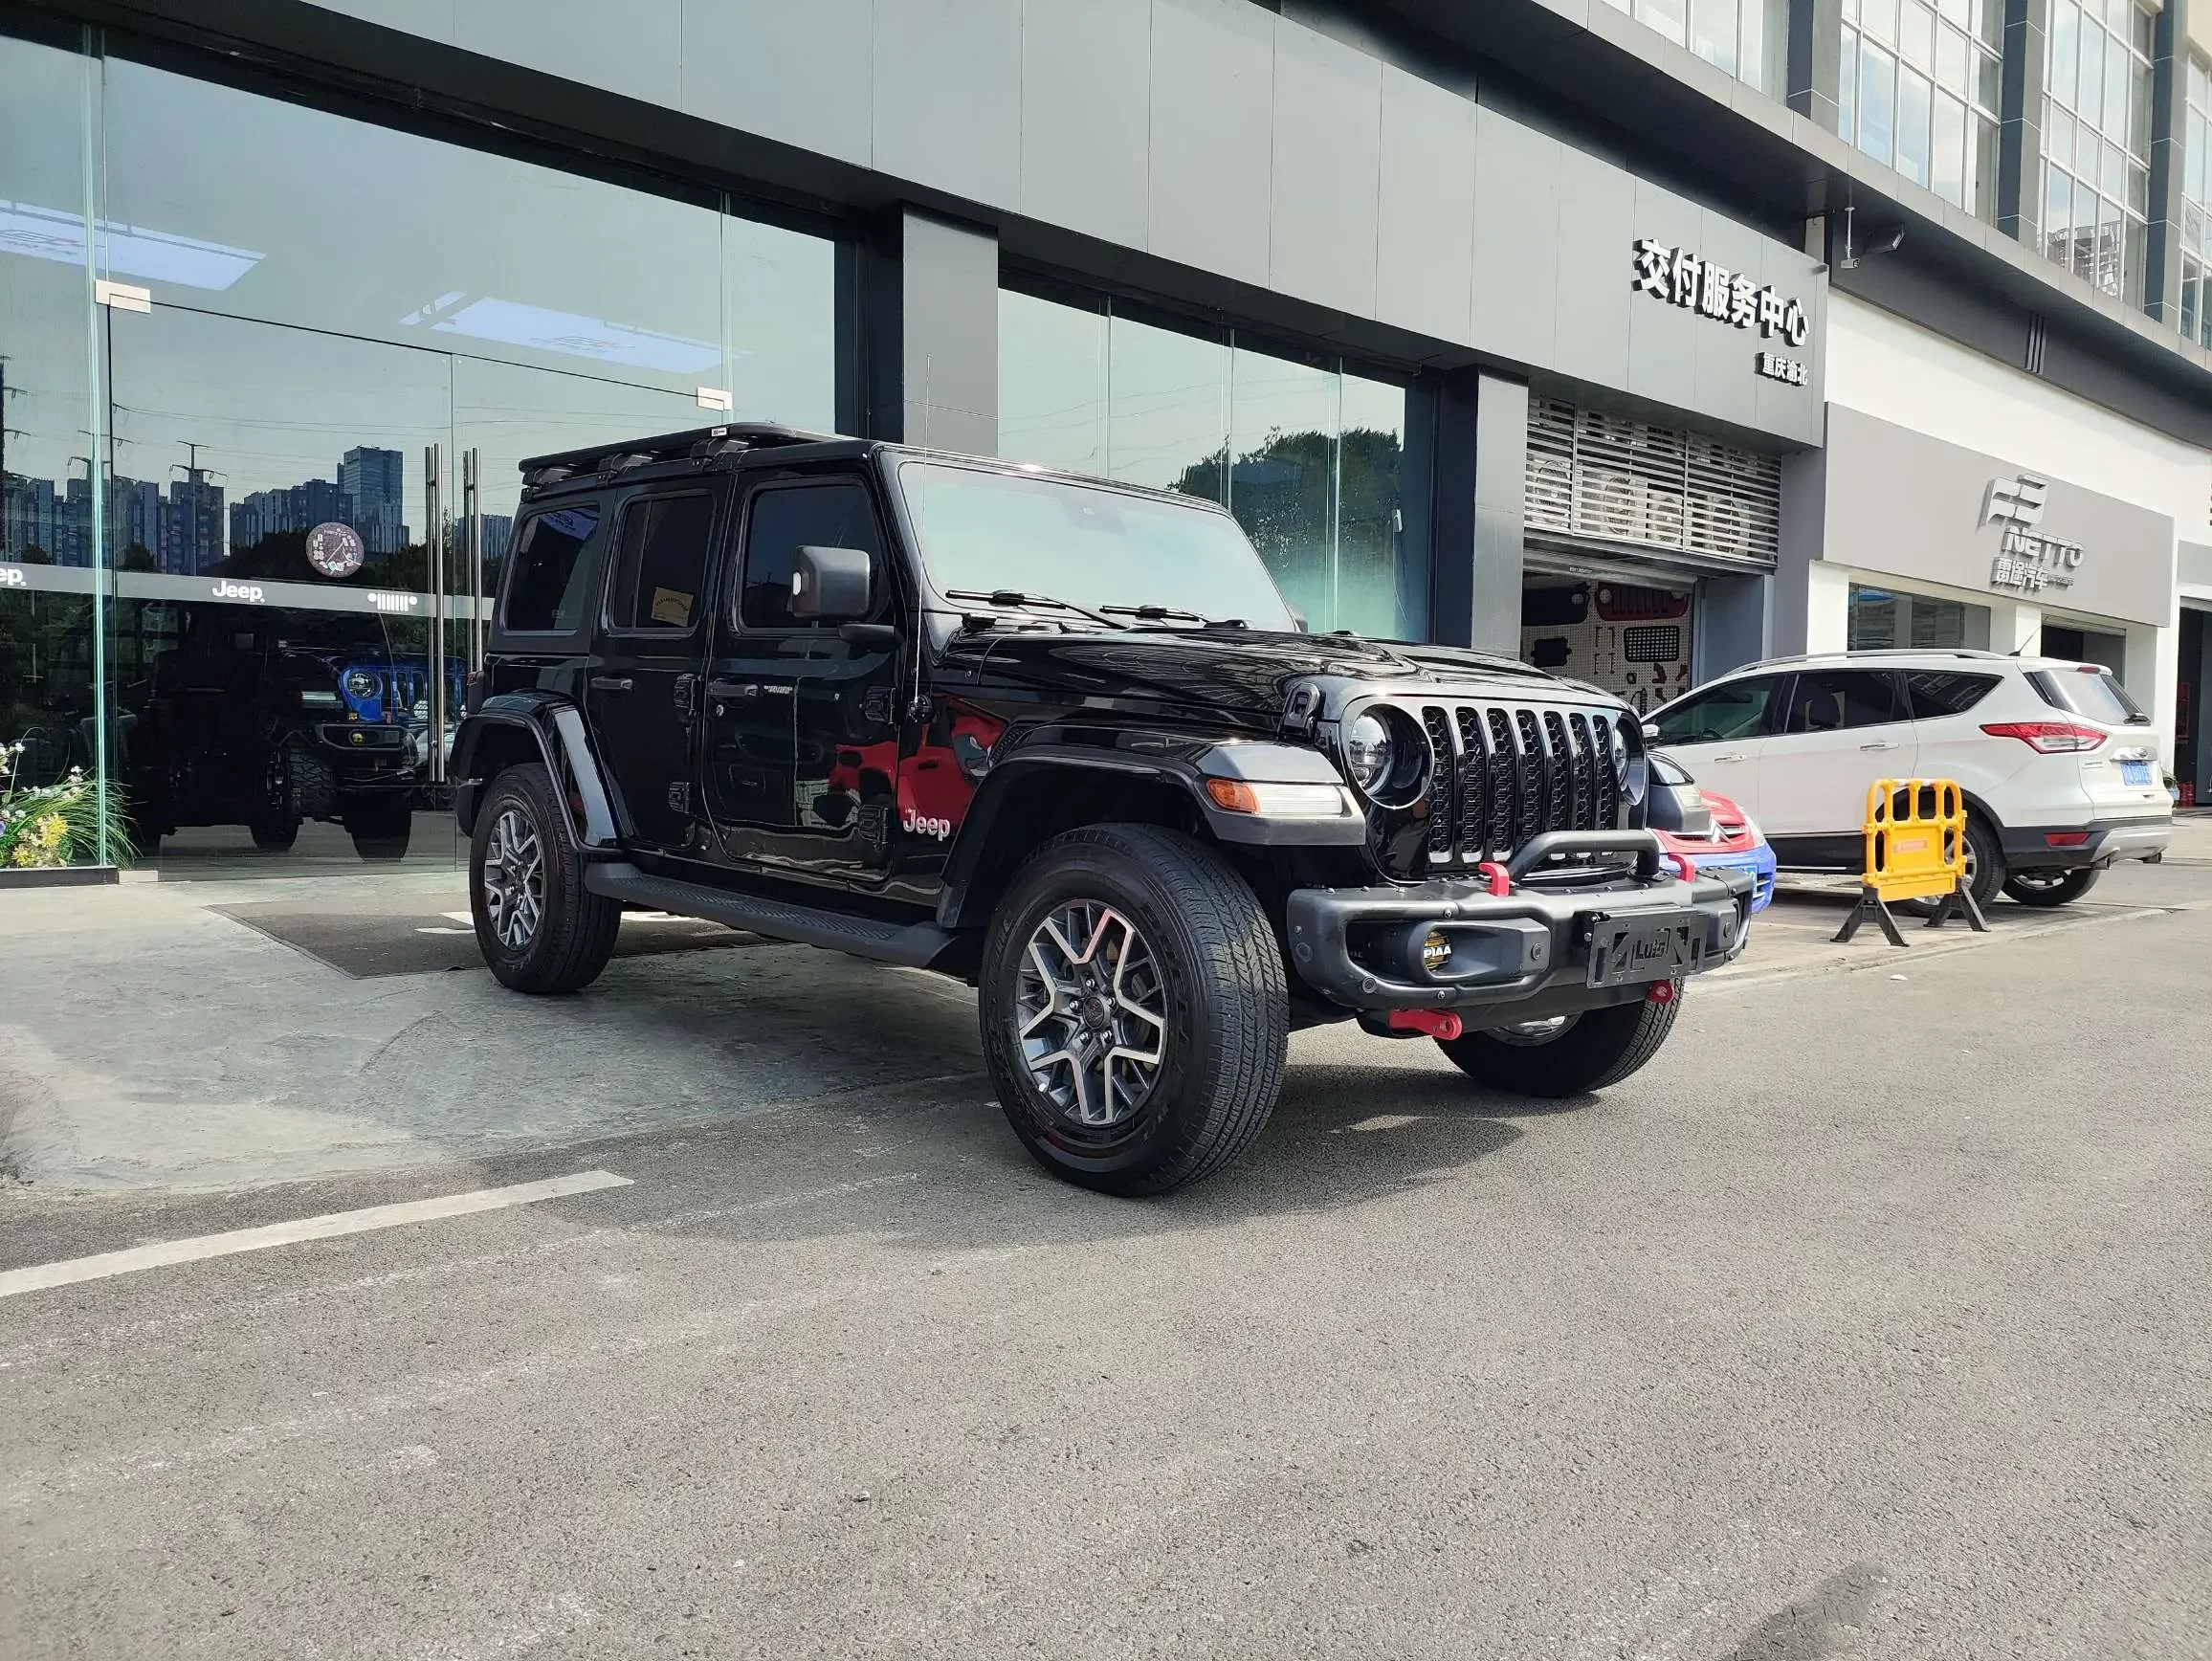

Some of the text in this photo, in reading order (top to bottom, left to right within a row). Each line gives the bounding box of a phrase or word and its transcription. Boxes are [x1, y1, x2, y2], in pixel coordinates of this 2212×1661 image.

[1635, 239, 1810, 346] 交付服务中心
[1762, 352, 1808, 386] 重庆渝北
[2004, 525, 2085, 568] NETTO
[902, 808, 951, 842] Jeep
[1423, 945, 1452, 959] PIAA
